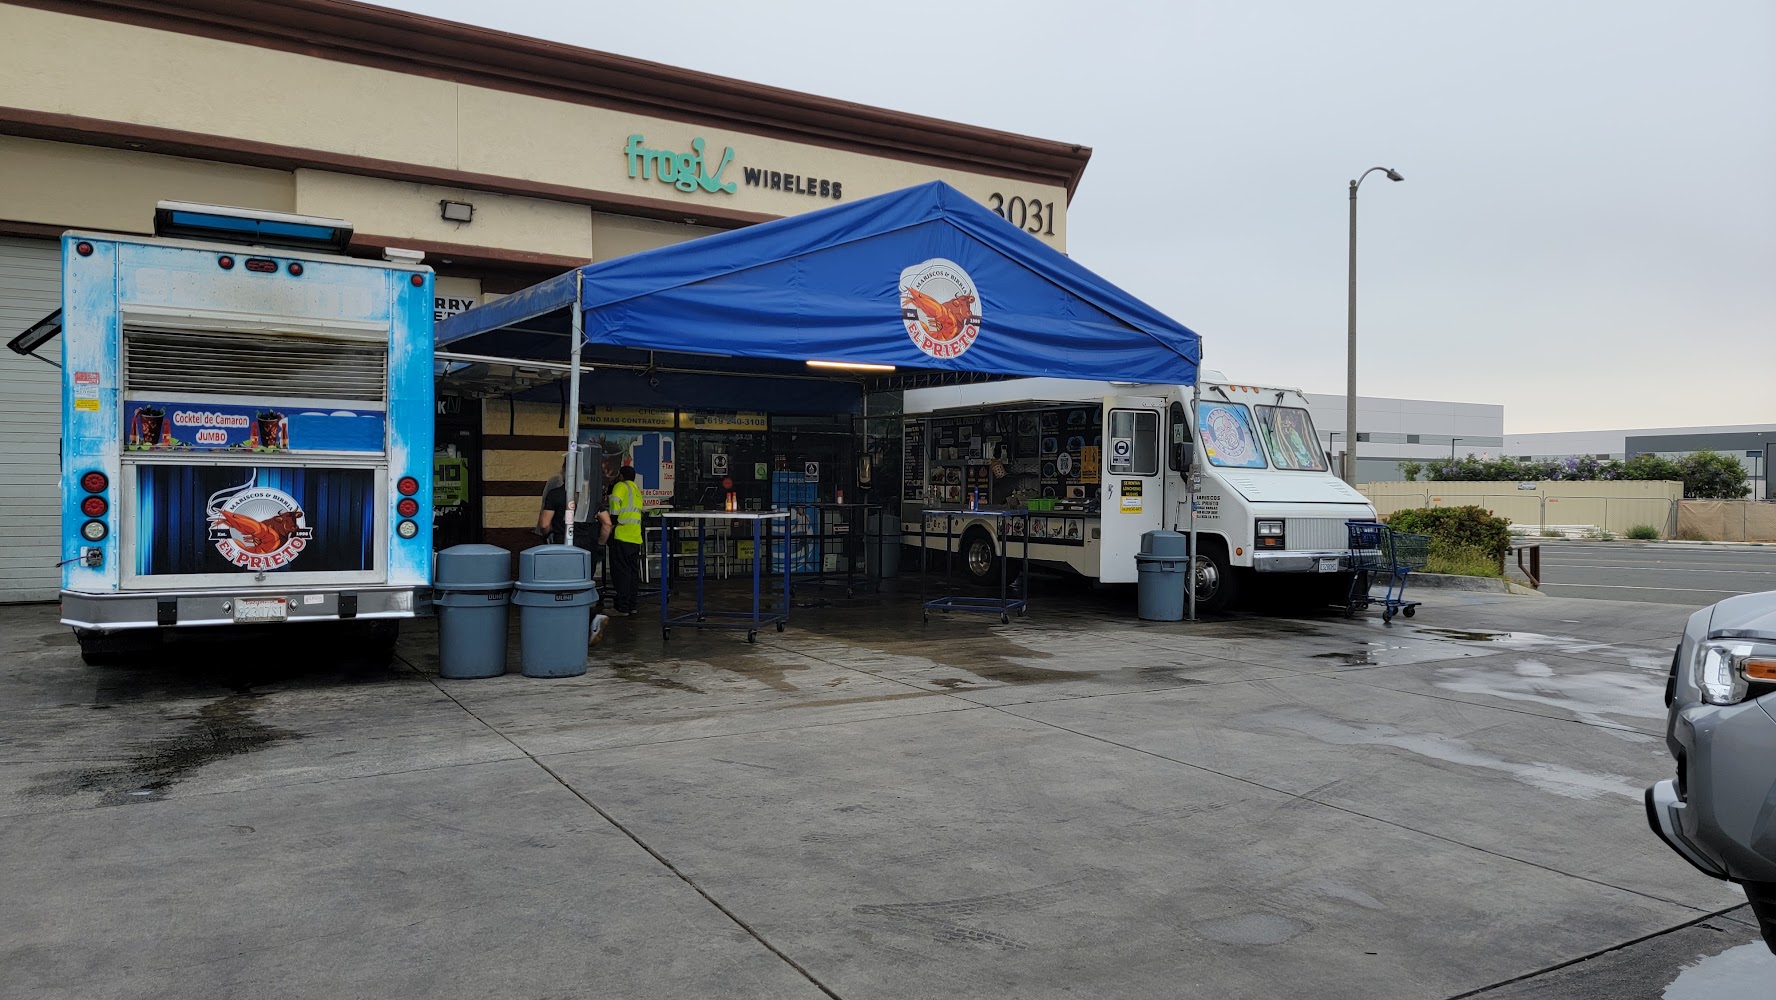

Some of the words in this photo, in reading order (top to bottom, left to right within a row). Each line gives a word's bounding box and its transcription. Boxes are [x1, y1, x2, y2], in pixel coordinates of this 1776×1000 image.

[744, 166, 843, 200] WIRELESS
[988, 192, 1055, 236] 3031
[908, 322, 921, 343] EL
[922, 324, 977, 357] PRIETO
[174, 412, 203, 424] Cocktel
[204, 415, 214, 424] de
[215, 415, 248, 426] Camaron
[198, 431, 226, 441] JUMBO
[229, 492, 264, 511] MARISCOS
[272, 494, 294, 511] BIRRIA
[219, 541, 234, 557] EL
[236, 537, 304, 568] PRIETO
